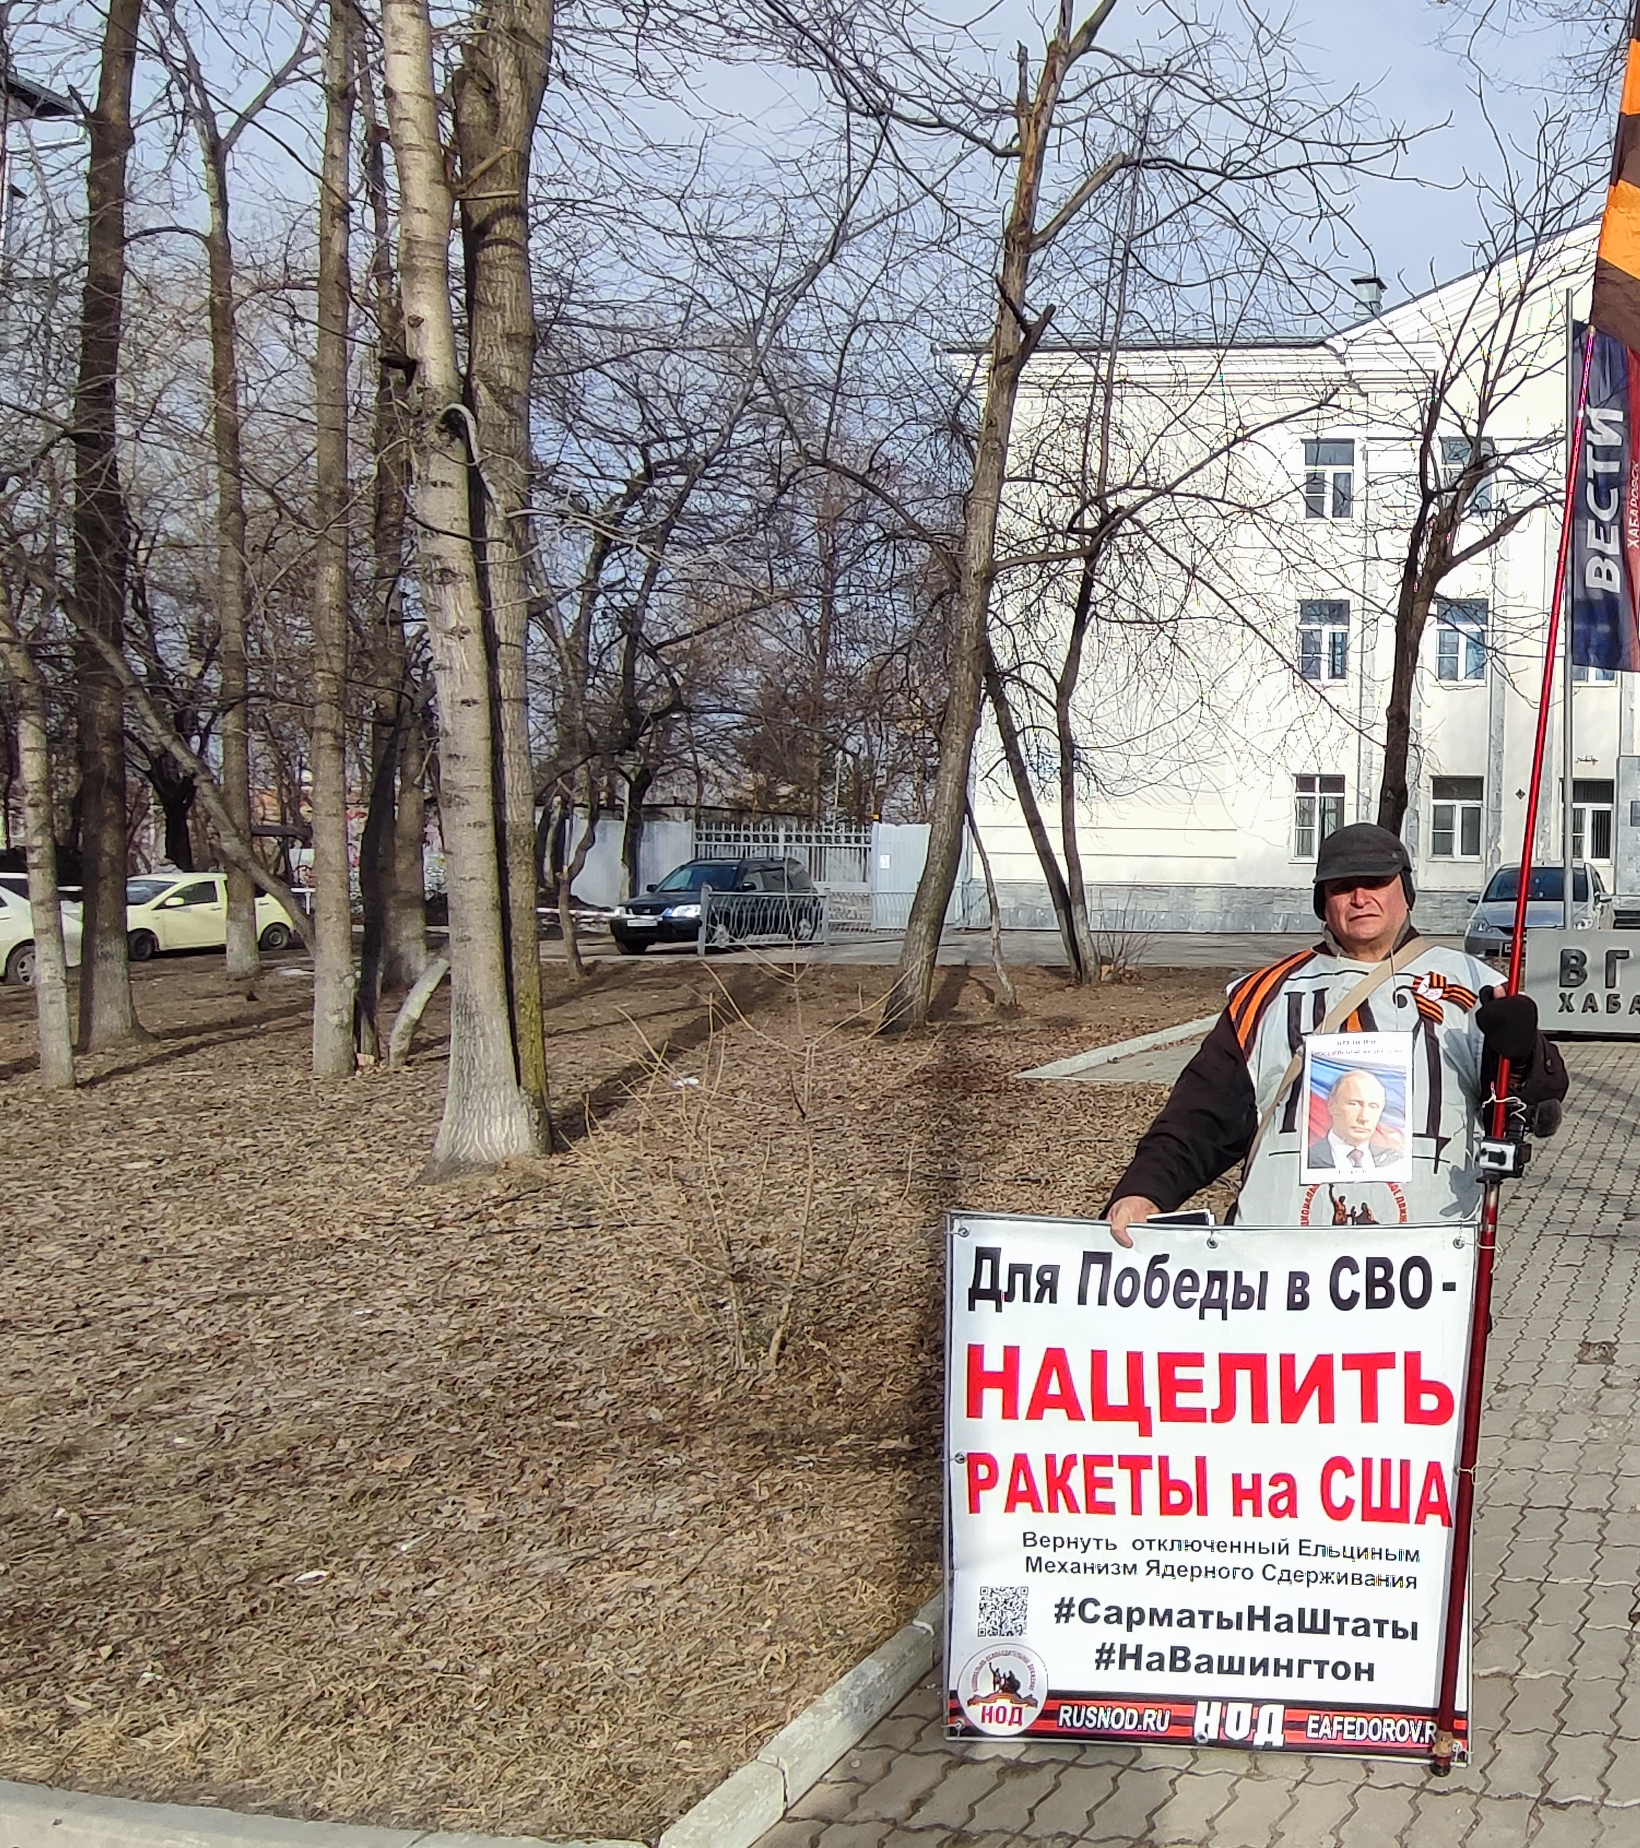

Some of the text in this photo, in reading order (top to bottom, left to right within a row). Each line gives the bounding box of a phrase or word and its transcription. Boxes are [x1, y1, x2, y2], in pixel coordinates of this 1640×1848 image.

[1585, 403, 1624, 594] ВЕСТИ
[968, 1246, 1060, 1313] Для
[1077, 1250, 1269, 1320] Победы
[1286, 1271, 1310, 1311] в
[965, 1343, 1455, 1437] НАЦЕЛИТЬ
[967, 1452, 1453, 1528] РАКЕТЫ на США
[1022, 1531, 1420, 1562] Вернуть отключенный Ельциным
[1025, 1556, 1418, 1590] Механизм Ядерного Сдерживания
[1054, 1597, 1418, 1641] #СарматыНаШтаты
[1095, 1643, 1375, 1682] #НаВашингтон
[981, 1705, 1024, 1727] НОД
[1058, 1705, 1172, 1733] RUSNOD.RU
[1194, 1700, 1285, 1748] НОД
[1306, 1714, 1438, 1745] EAFEDOROV.R
